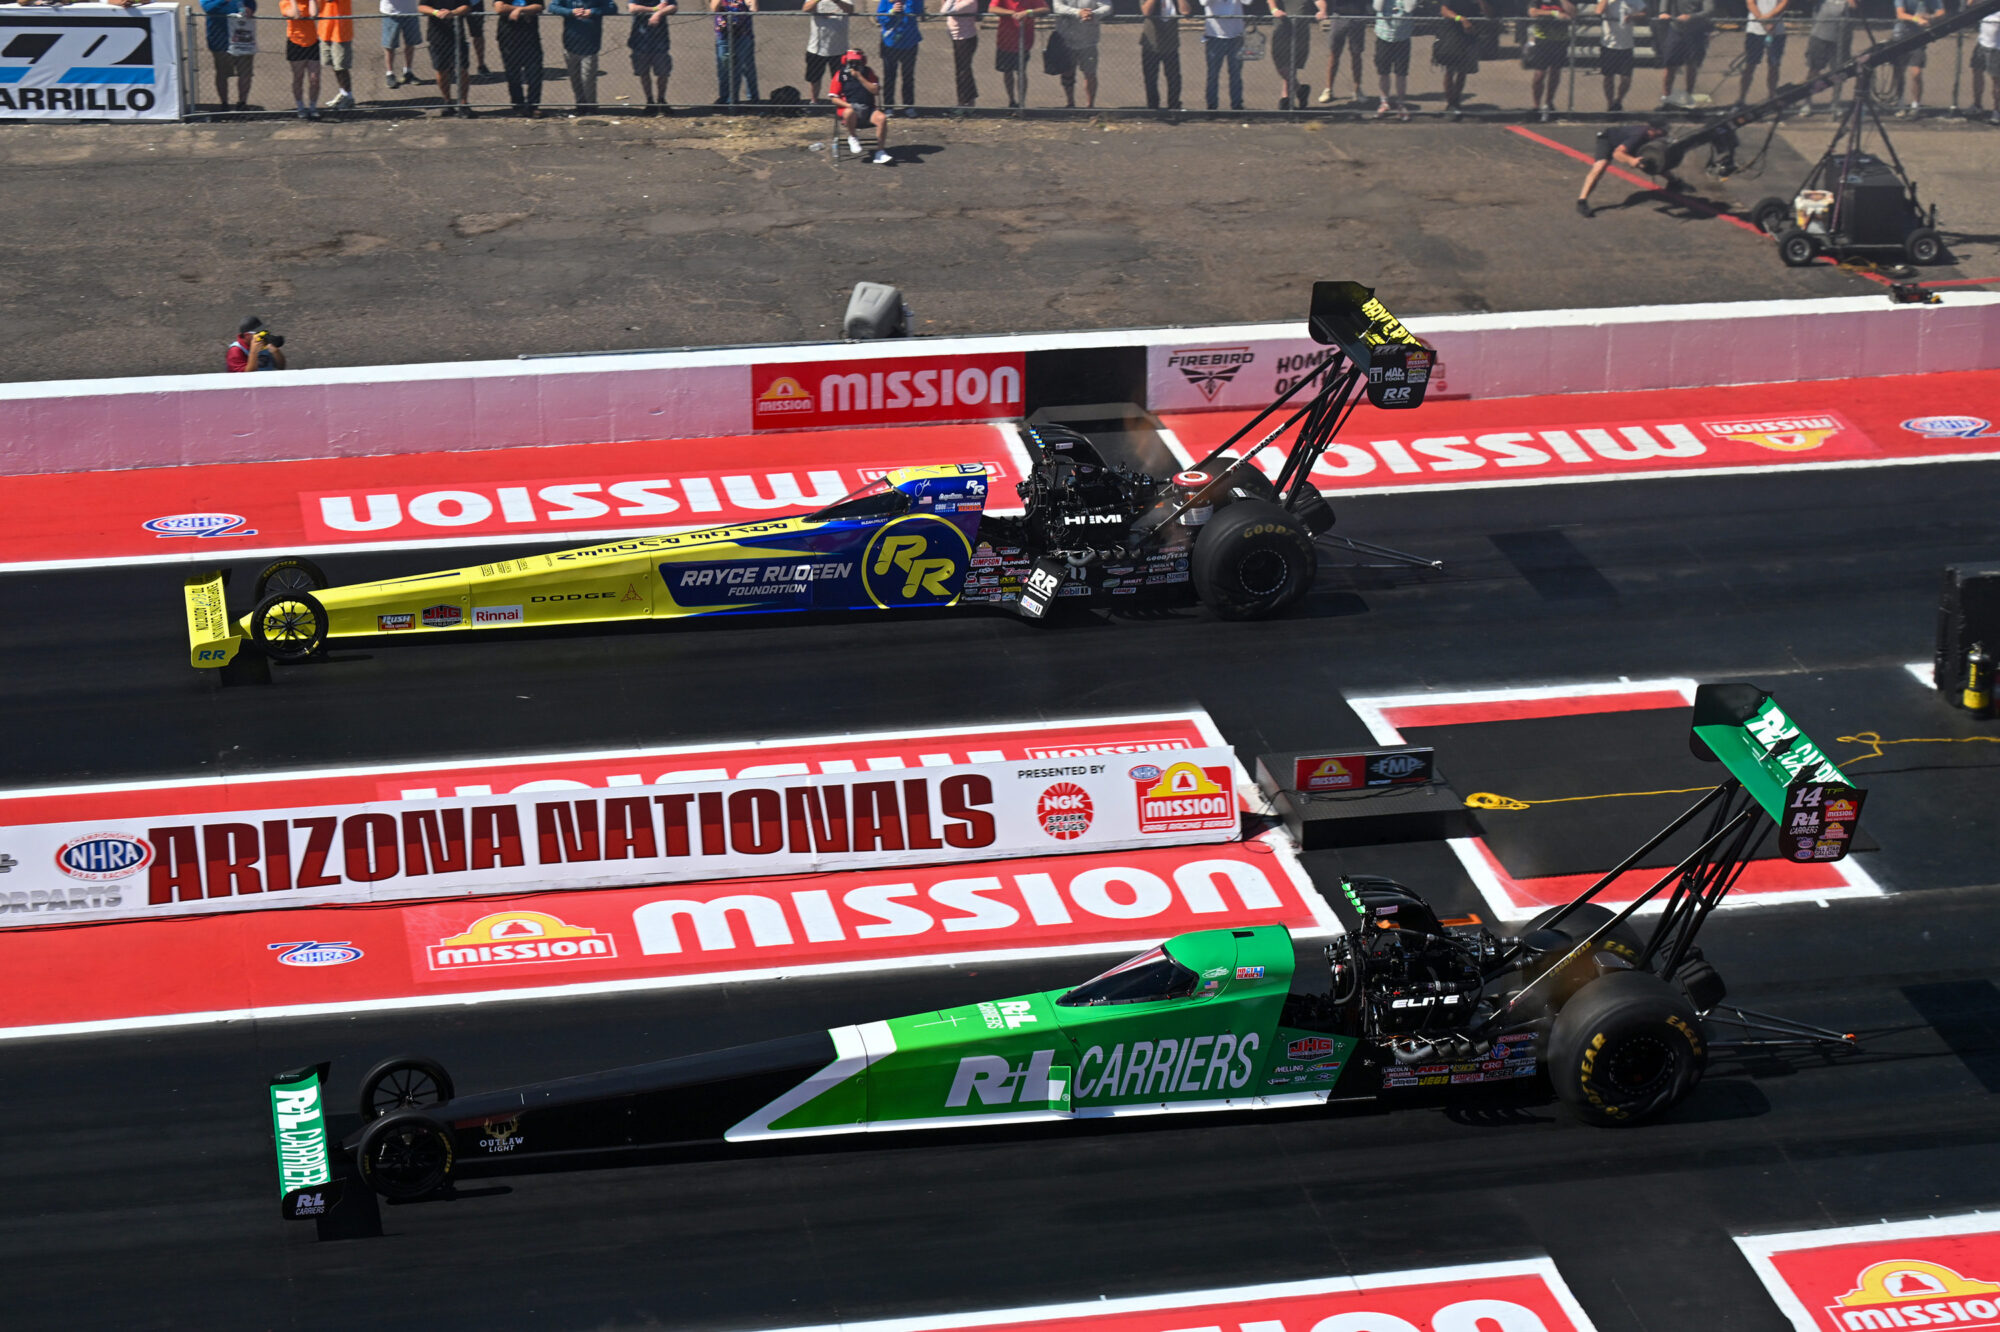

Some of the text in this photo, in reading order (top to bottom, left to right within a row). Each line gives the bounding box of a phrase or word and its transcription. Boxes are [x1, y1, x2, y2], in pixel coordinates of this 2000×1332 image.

[1168, 352, 1254, 367] FIREBIRD
[1385, 367, 1405, 377] MAC
[1383, 387, 1411, 399] RR
[165, 516, 231, 530] NHRA
[874, 535, 955, 598] RR
[972, 558, 1001, 567] SIMPSON
[680, 563, 853, 586] RAYCE RUDEEN
[1029, 567, 1058, 597] RR
[531, 592, 616, 603] DODGE
[728, 584, 807, 597] FOUNDATION
[424, 608, 459, 619] JHG
[476, 610, 519, 622] Rinnai
[198, 650, 226, 660] RR
[1018, 764, 1106, 779] PRESENTED BY
[1378, 757, 1424, 774] FMP
[1044, 795, 1085, 811] NGK
[1791, 787, 1823, 808] 14
[1048, 814, 1084, 823] SPARK
[1792, 812, 1820, 826] R+L
[1049, 823, 1086, 832] PLUGS
[1142, 820, 1234, 832] DRAG RACING SERIES
[68, 832, 135, 847] CHAMPIONSHIP
[148, 773, 996, 905] ARIZONA NATIONALS
[71, 841, 140, 870] NHRA
[71, 869, 98, 880] DRAG
[293, 950, 346, 962] NHRA
[1392, 995, 1459, 1009] ELITE
[976, 1002, 1005, 1029] CARRIERS
[997, 1000, 1037, 1029] R+L
[1666, 1015, 1702, 1056] EAGLE
[1290, 1039, 1331, 1053] JHG
[1074, 1032, 1259, 1099] CARRIERS
[1418, 1065, 1449, 1073] ARP
[944, 1049, 1067, 1107] R+L
[1419, 1076, 1449, 1086] JEGS
[275, 1085, 320, 1130] R+L
[480, 1137, 524, 1147] OUTLAW
[296, 1193, 325, 1208] R+L
[295, 1206, 325, 1216] CARRIERS
[1842, 1298, 2000, 1331] MISSIO
